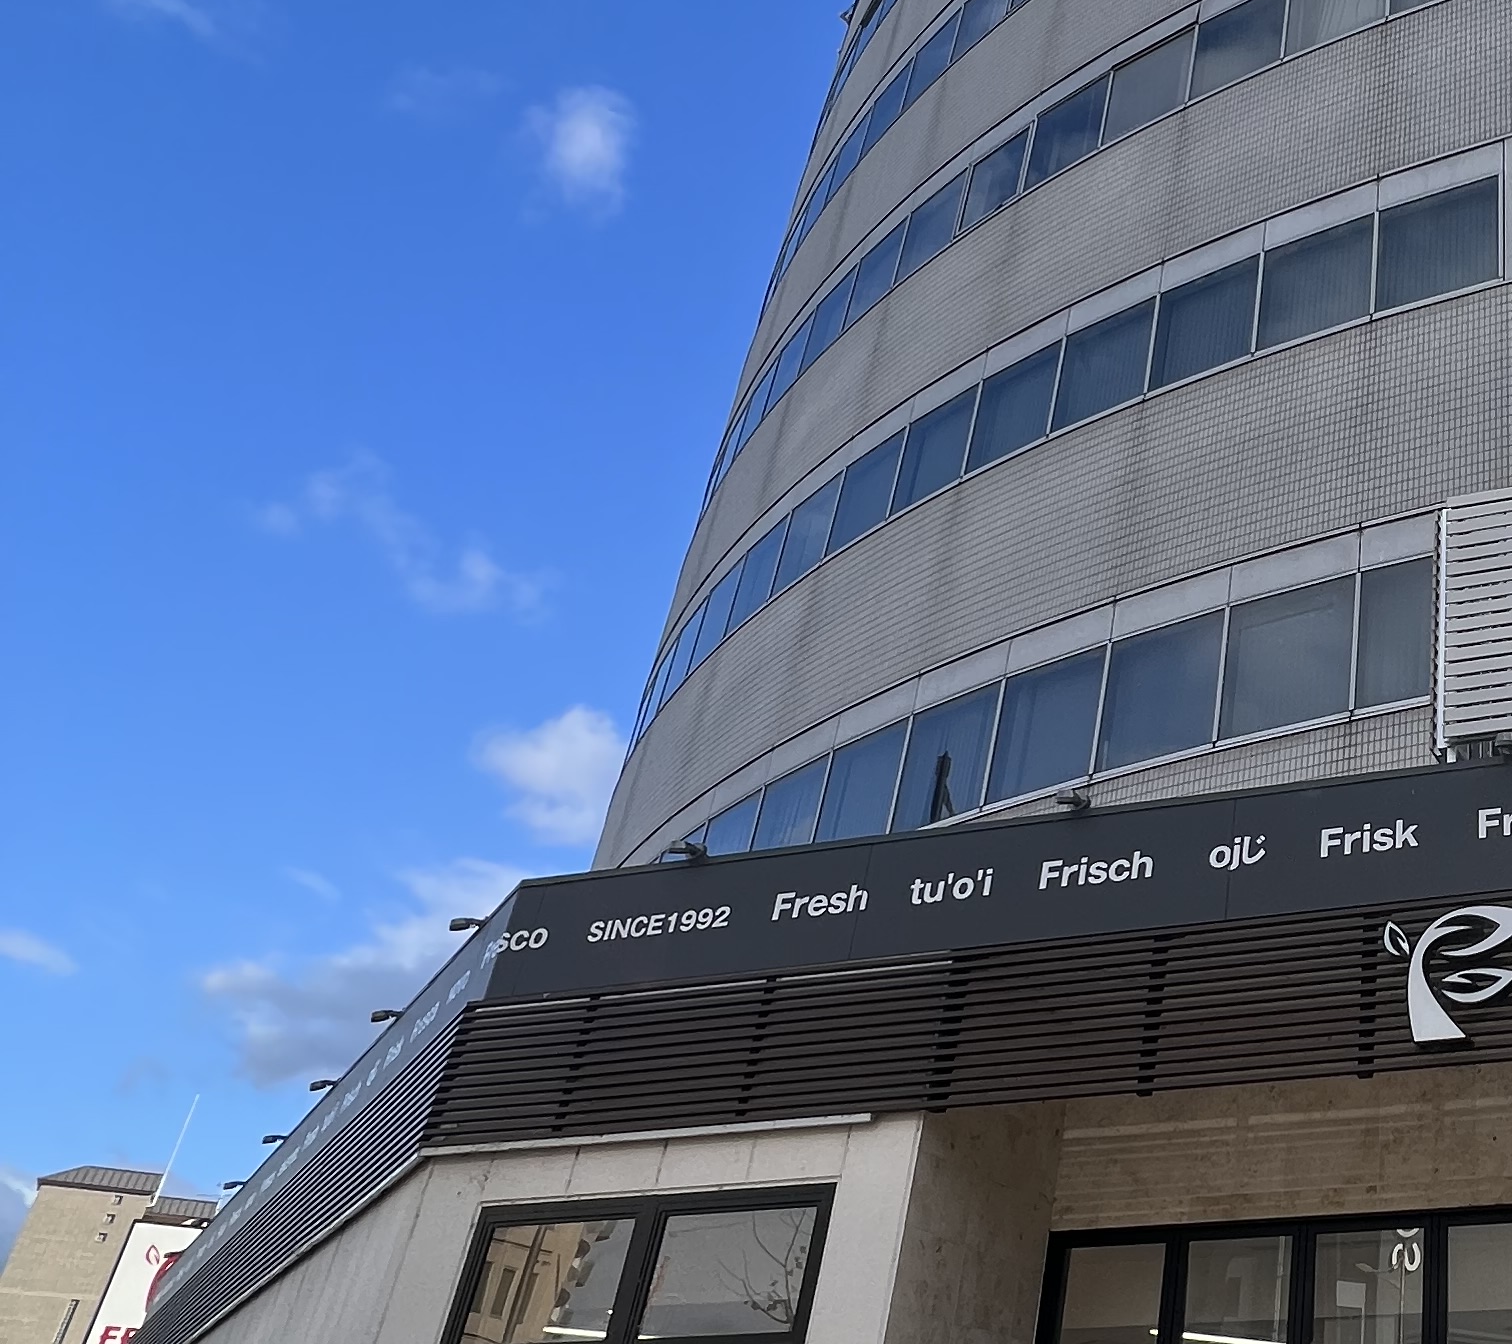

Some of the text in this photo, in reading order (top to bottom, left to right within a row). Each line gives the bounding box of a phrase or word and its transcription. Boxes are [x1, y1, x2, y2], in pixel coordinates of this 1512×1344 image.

[1320, 819, 1419, 858] Frisk
[587, 906, 731, 943] SINCE1992
[771, 884, 869, 921] Fresh
[1038, 850, 1154, 890] Frisch
